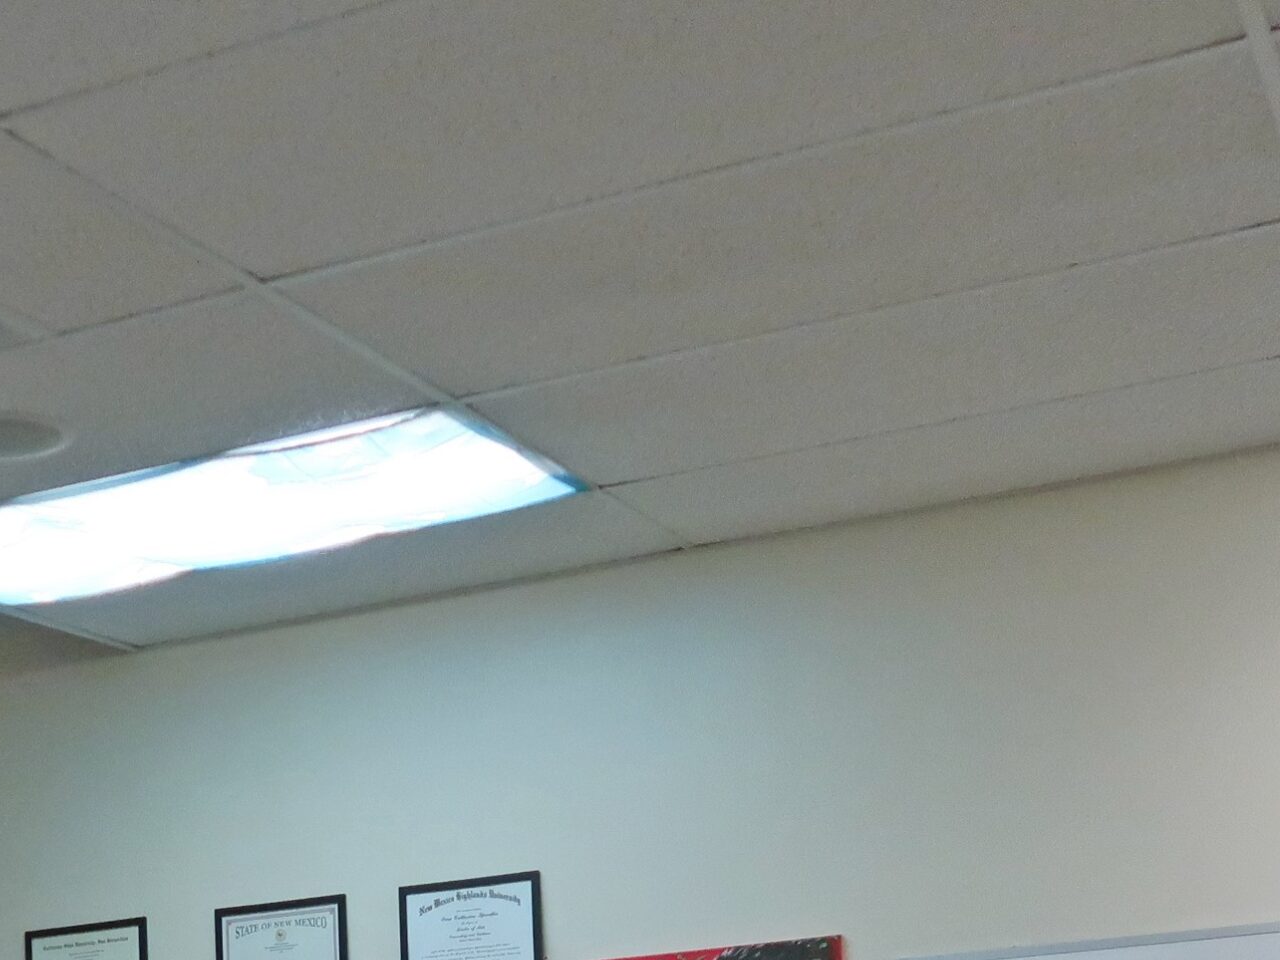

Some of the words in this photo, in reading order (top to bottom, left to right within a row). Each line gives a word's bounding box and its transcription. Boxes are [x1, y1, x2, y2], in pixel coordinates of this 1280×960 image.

[235, 924, 259, 939] STATE
[260, 922, 271, 930] OF
[273, 919, 292, 928] NEW
[294, 916, 327, 929] MEXICO
